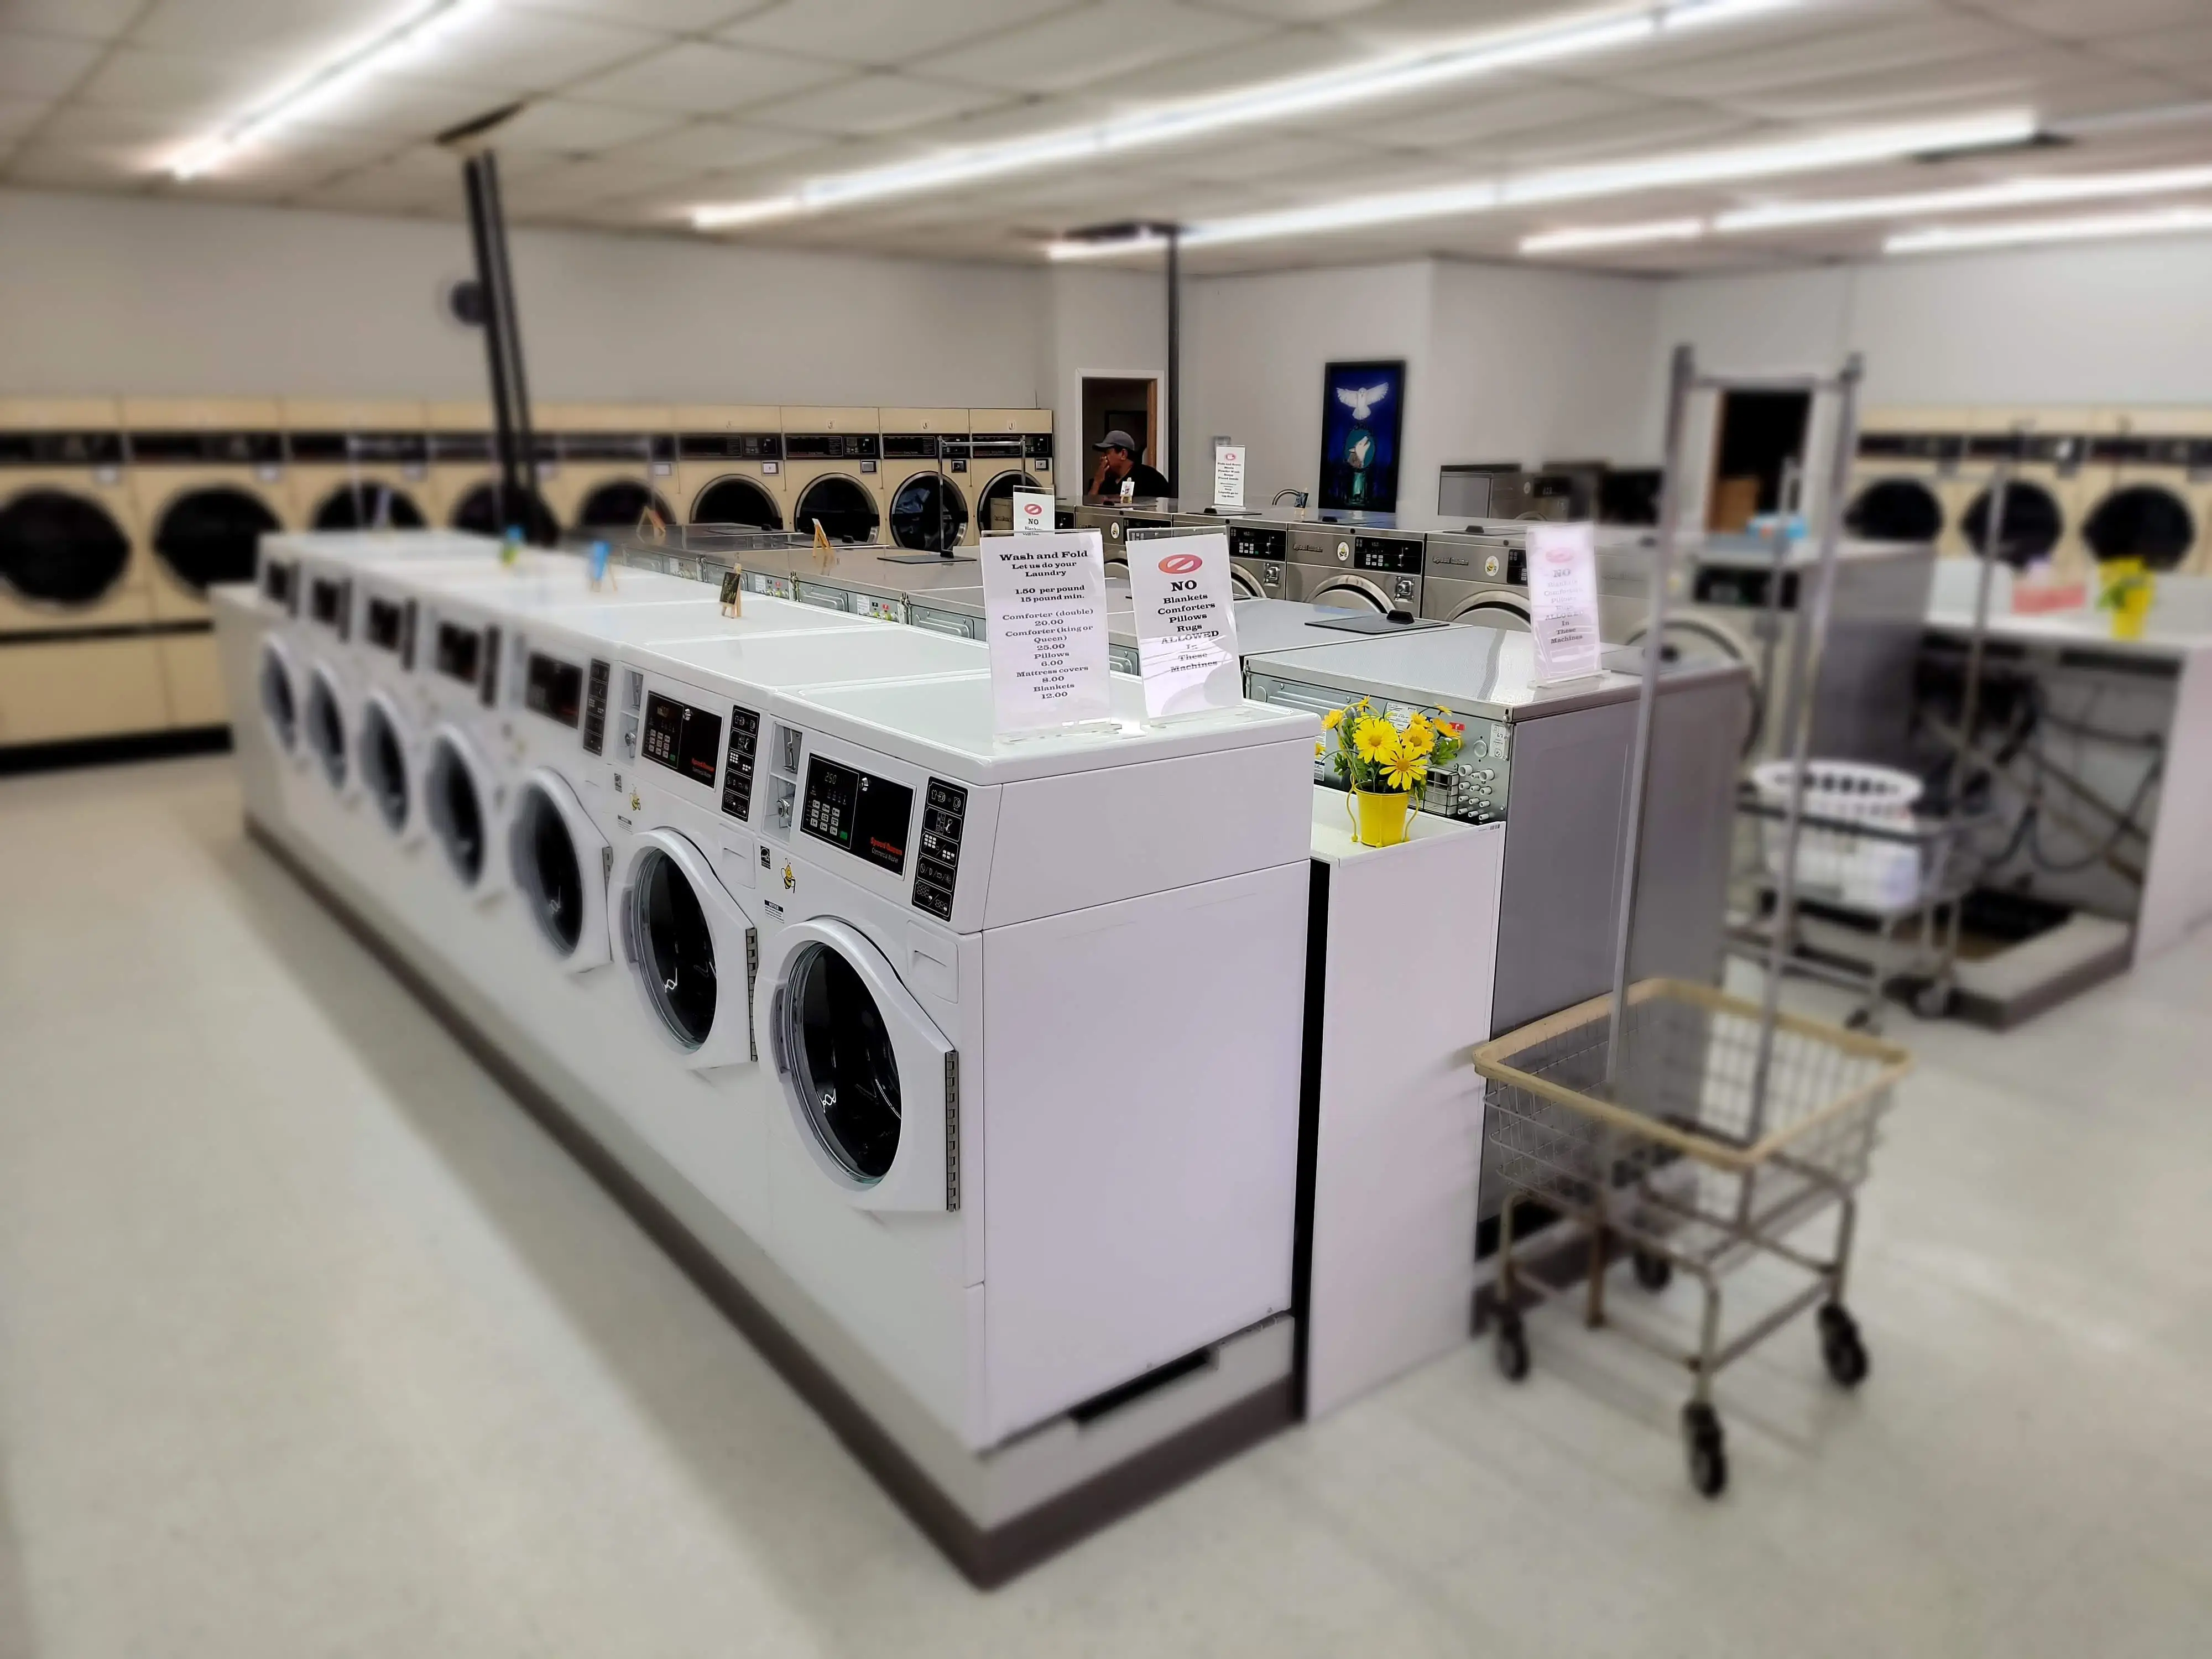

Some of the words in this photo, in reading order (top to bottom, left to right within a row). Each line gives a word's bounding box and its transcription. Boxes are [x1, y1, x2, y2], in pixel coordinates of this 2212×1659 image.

[1553, 568, 1571, 577] NO
[1170, 580, 1197, 592] NO
[1033, 594, 1062, 603] pound
[1164, 594, 1208, 604] Blankets
[1158, 603, 1215, 615] Comforters
[1002, 612, 1053, 620] Comforter
[1056, 608, 1093, 617] (double)
[1169, 614, 1207, 623] Pillows
[1005, 629, 1056, 637] Comforter
[1161, 630, 1219, 644] ALLOWED
[1034, 635, 1067, 644] Queen)
[1551, 635, 1583, 644] Machines
[1178, 653, 1208, 661] These
[1170, 661, 1218, 672] Machines
[1016, 669, 1057, 677] Mattress
[1033, 684, 1074, 692] Blankets
